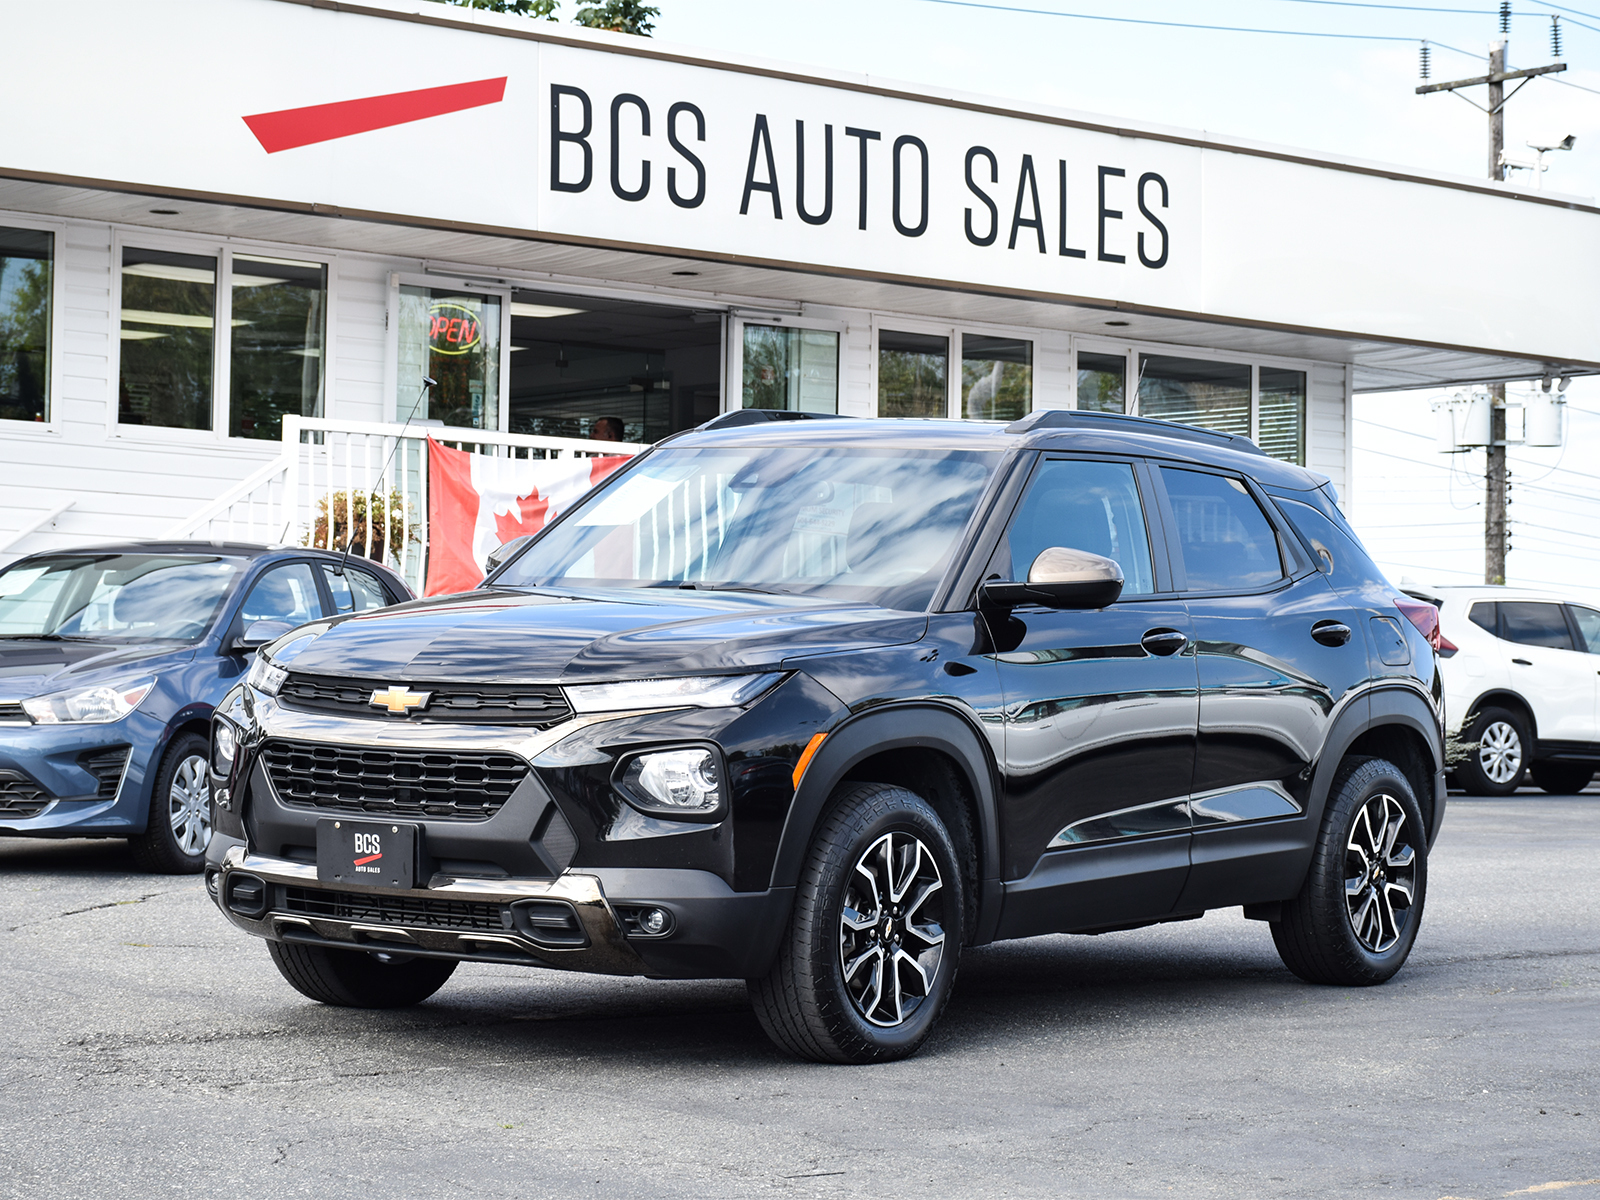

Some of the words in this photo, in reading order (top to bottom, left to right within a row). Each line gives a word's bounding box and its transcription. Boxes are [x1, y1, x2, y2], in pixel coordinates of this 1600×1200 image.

[550, 83, 706, 208] BCS
[739, 113, 929, 238] AUTO
[964, 145, 1169, 270] SALES
[354, 833, 381, 854] BCS
